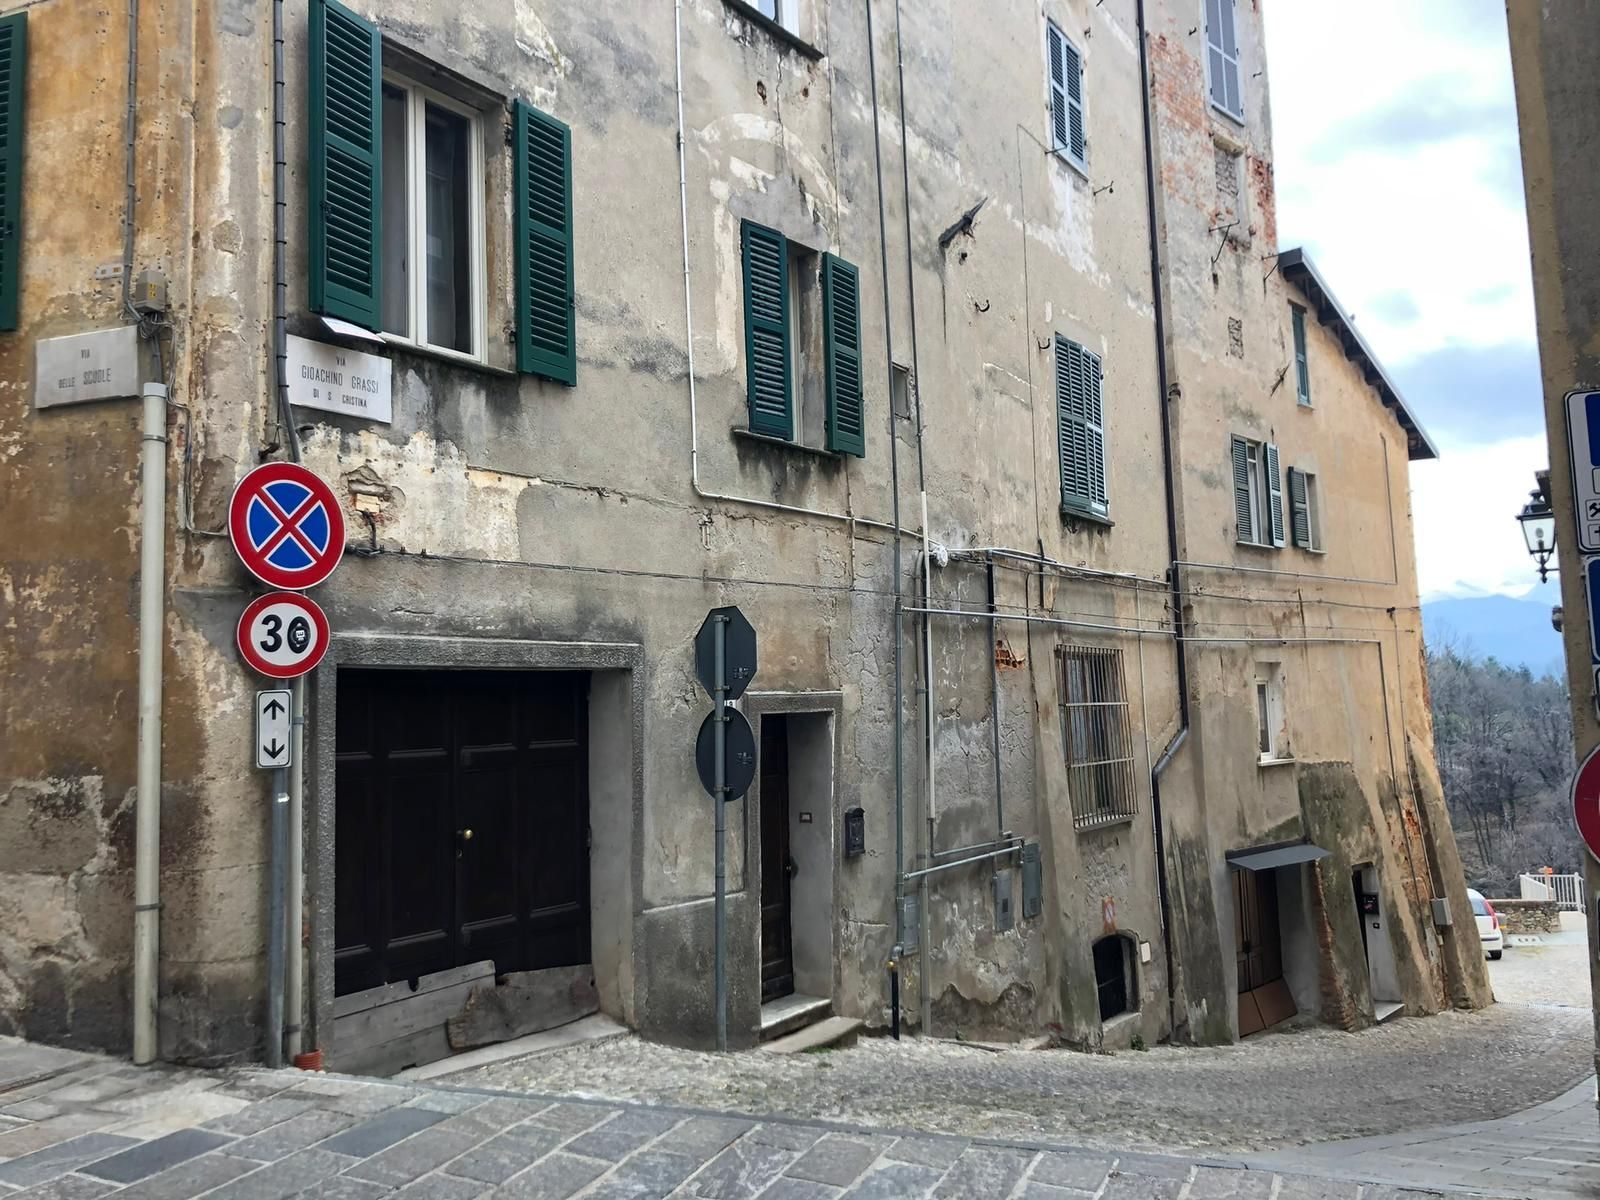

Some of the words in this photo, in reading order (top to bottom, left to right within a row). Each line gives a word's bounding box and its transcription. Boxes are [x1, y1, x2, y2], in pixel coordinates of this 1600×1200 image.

[336, 356, 346, 366] VIA
[83, 368, 111, 385] SCUOLE
[301, 365, 343, 386] GIOACHINO
[351, 376, 379, 394] GRASSI
[313, 388, 320, 398] DI
[342, 395, 368, 408] CRISTINA
[260, 614, 311, 654] 30
